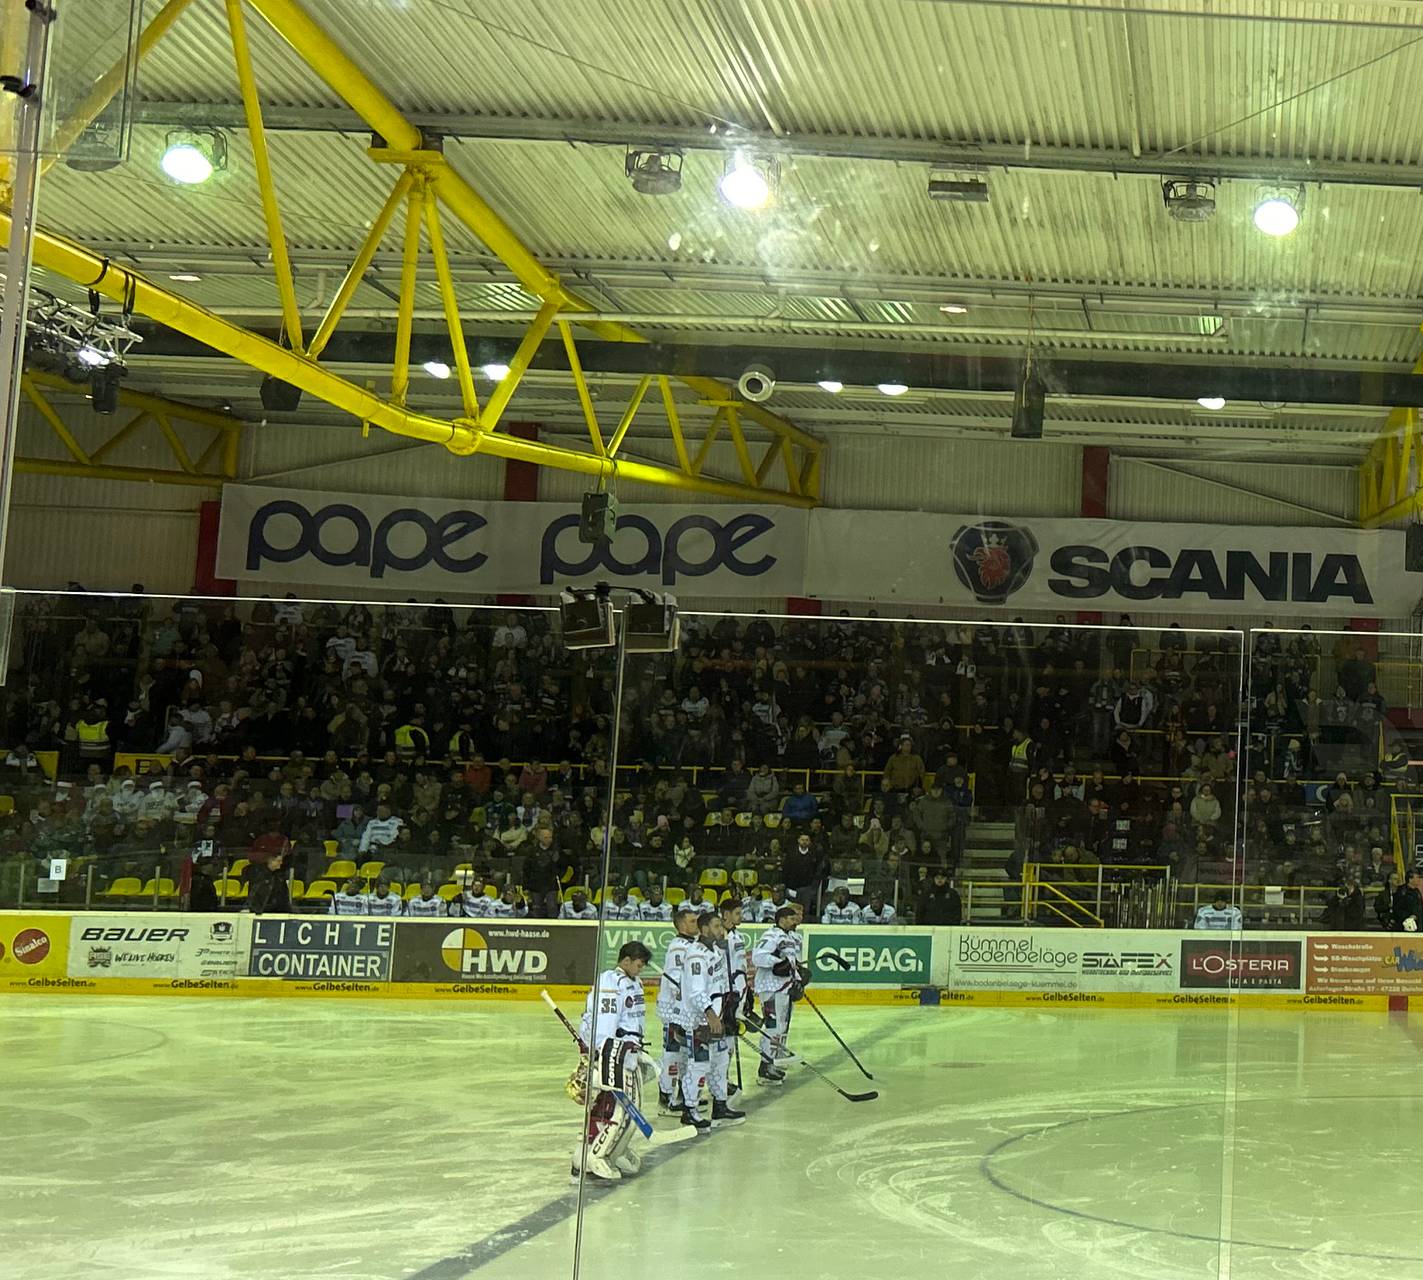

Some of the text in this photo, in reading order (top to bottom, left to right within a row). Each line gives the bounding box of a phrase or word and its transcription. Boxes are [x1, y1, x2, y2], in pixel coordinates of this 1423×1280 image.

[246, 501, 488, 578] pape
[540, 514, 777, 586] pape
[1048, 545, 1374, 605] SCANIA
[55, 866, 62, 874] B
[14, 935, 48, 957] Sinalco
[254, 922, 391, 946] LICHTE
[960, 934, 1034, 951] Kümmel
[258, 953, 381, 977] CONTAINER
[462, 949, 548, 974] HWD
[815, 947, 917, 973] GEBAG
[958, 948, 1078, 968] Bodenbeläge
[1192, 955, 1289, 974] L'OSTERIA
[600, 998, 617, 1014] 35
